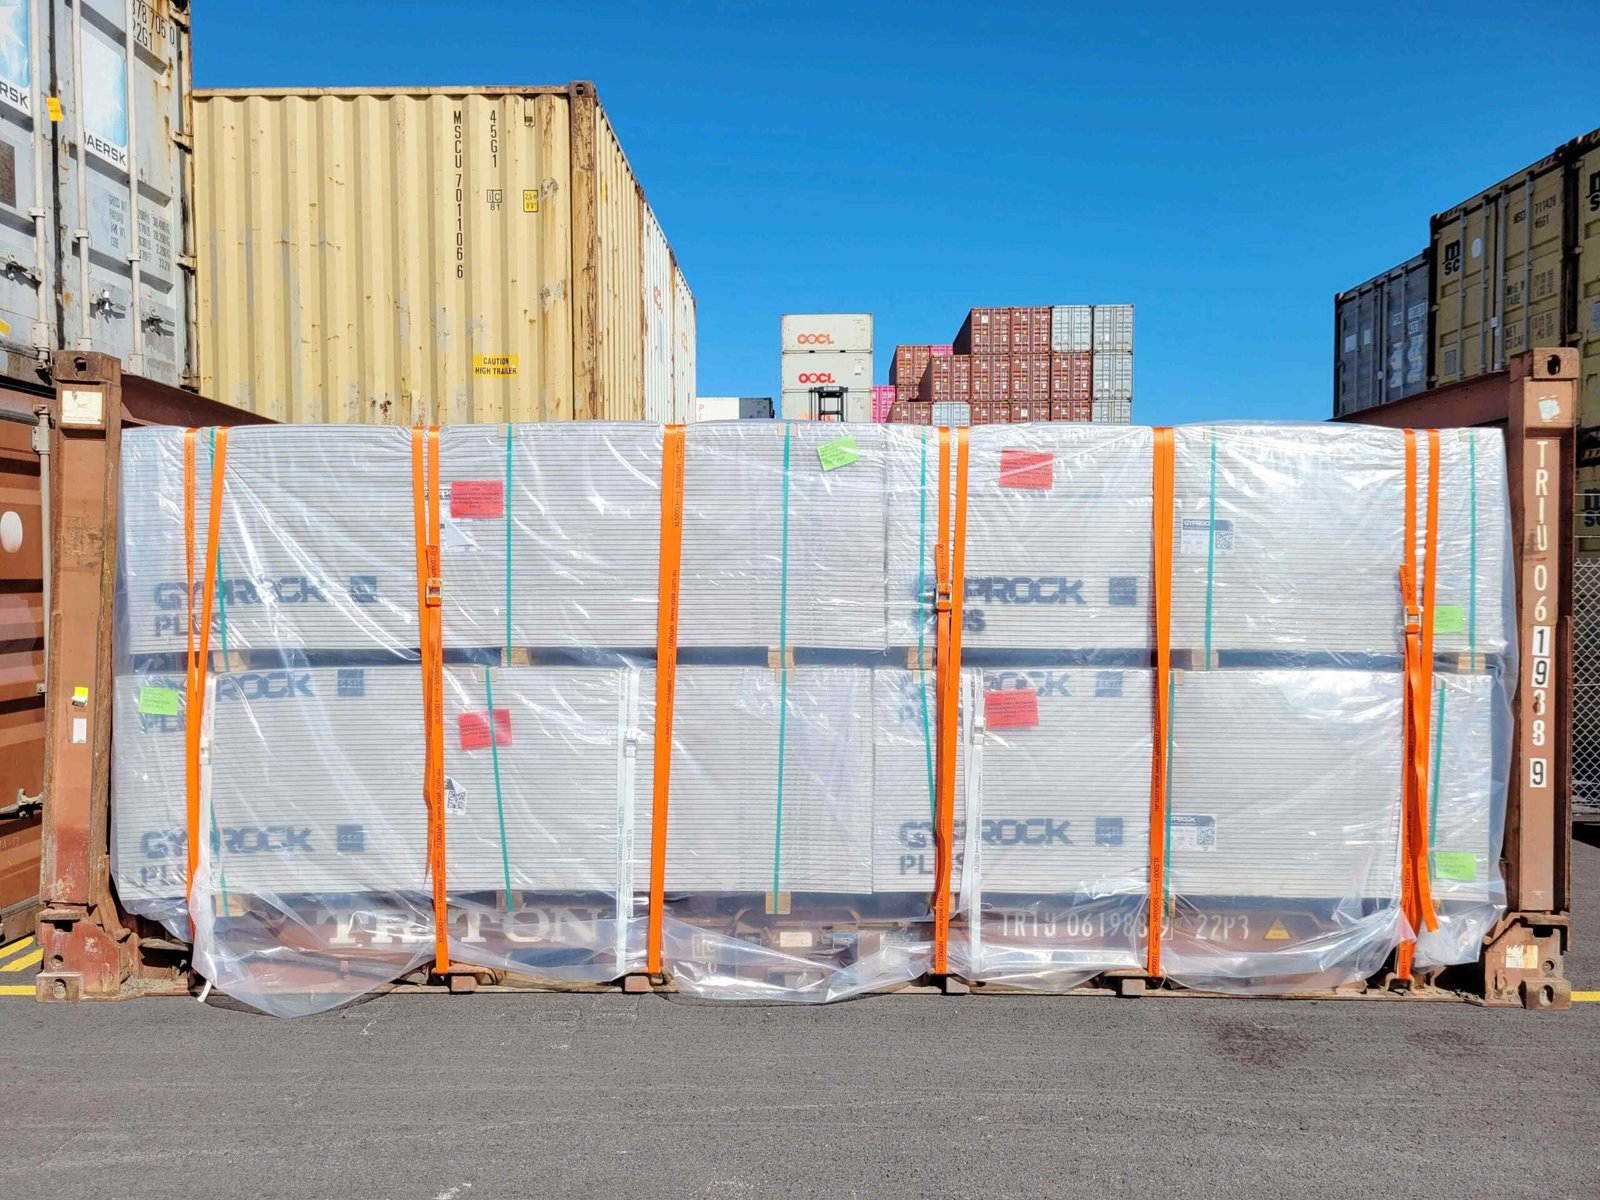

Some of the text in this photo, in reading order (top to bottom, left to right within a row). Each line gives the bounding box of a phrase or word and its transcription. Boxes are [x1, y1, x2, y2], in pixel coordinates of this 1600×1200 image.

[84, 131, 127, 166] AERSK
[490, 109, 498, 168] 45G1
[453, 110, 464, 279] MSCU 701106 6
[797, 333, 834, 345] OOCL
[475, 367, 517, 375] HIGH TRAILER
[483, 357, 509, 365] CAUTION
[798, 373, 835, 384] OOCL
[1535, 440, 1548, 551] TRIU
[316, 907, 602, 944] TRTON
